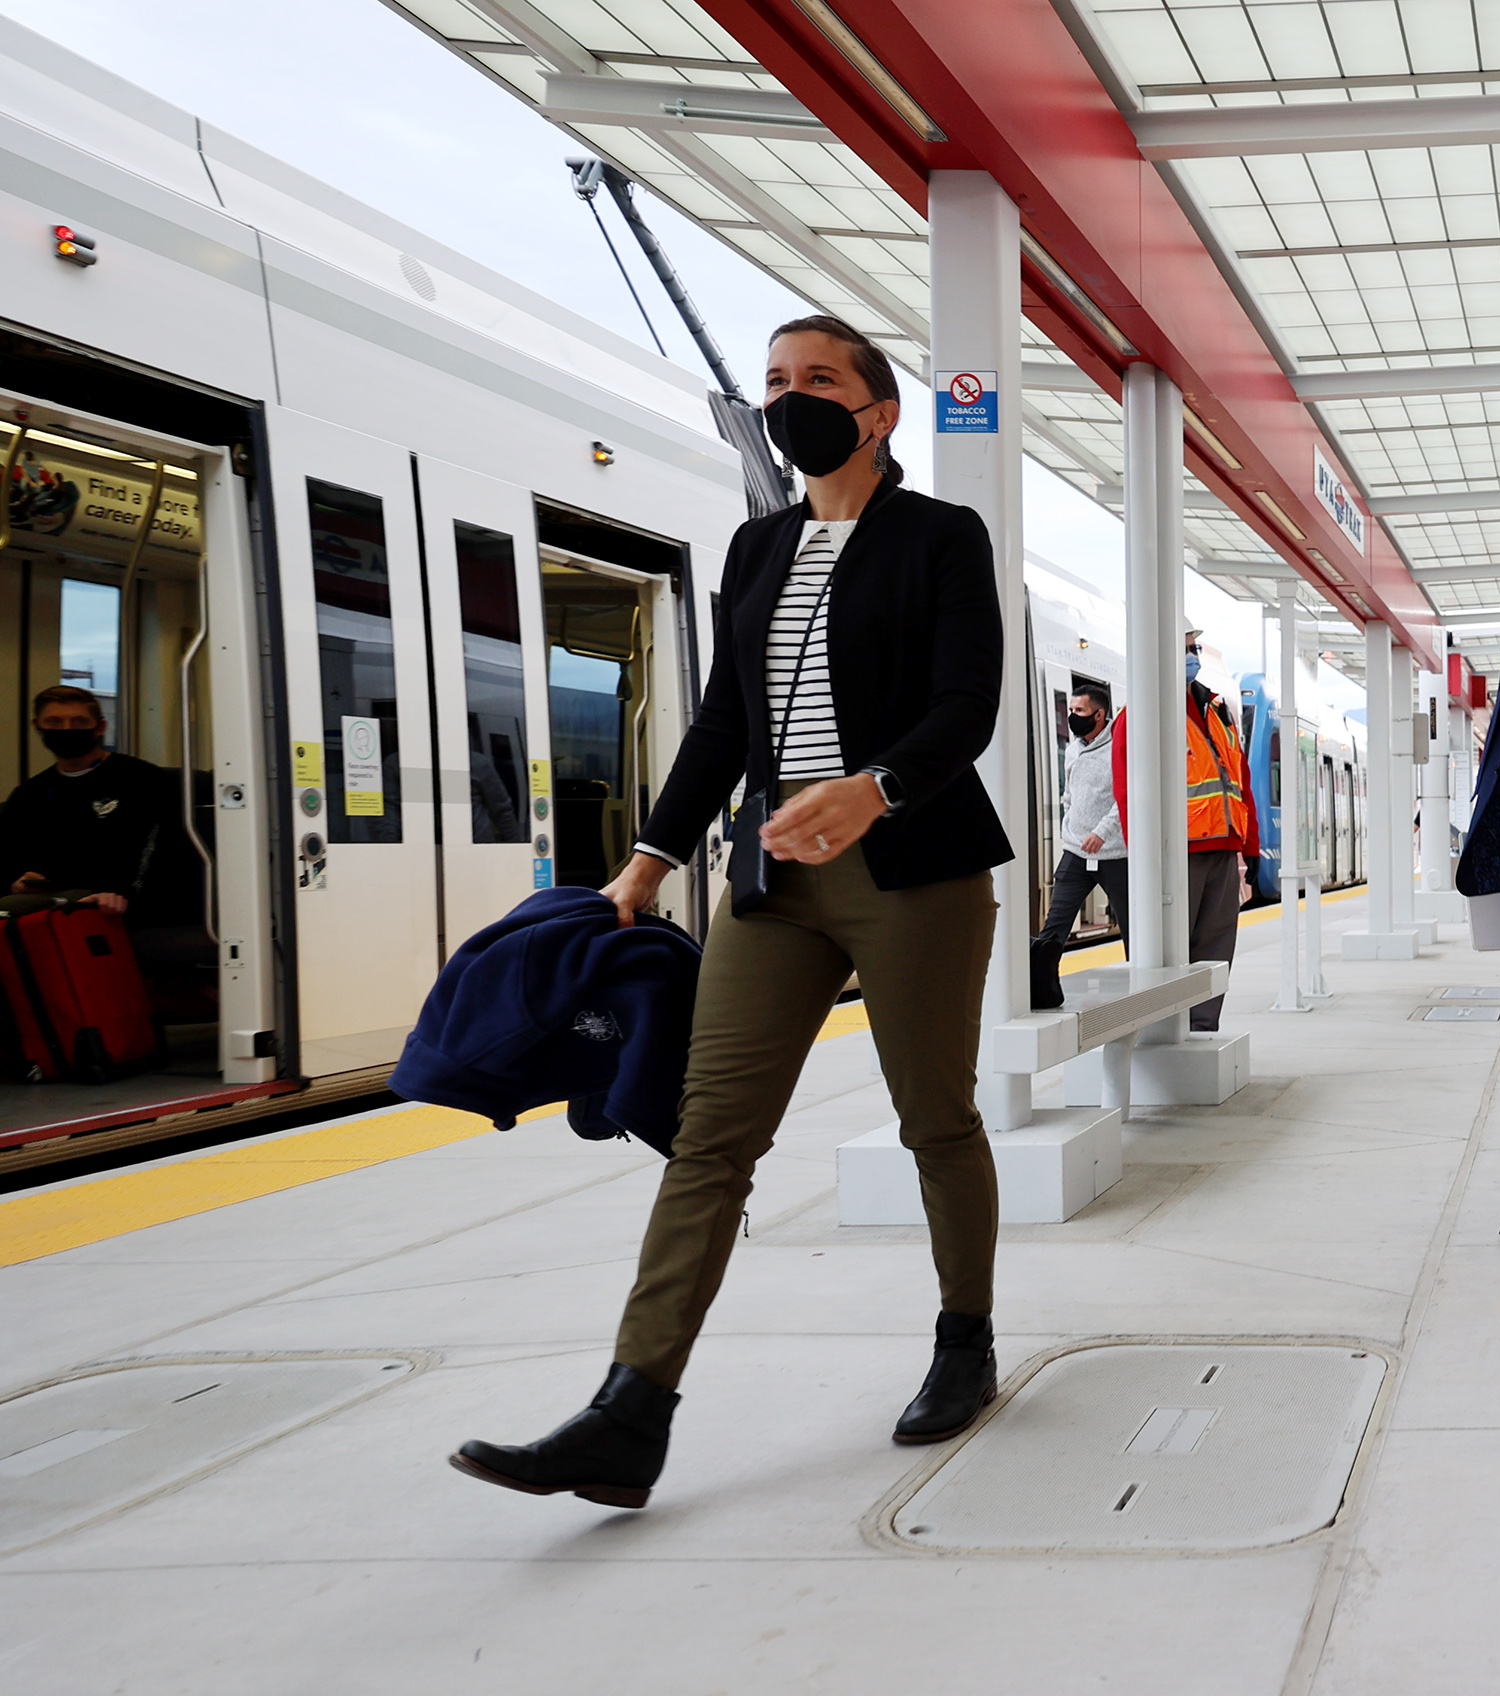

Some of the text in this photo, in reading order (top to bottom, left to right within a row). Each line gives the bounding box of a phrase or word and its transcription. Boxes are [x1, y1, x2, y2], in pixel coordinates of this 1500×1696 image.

[947, 407, 986, 415] TOBACCO
[87, 477, 126, 502] Find
[132, 489, 142, 505] a
[1319, 463, 1335, 506] UTA
[85, 504, 193, 540] career oday.
